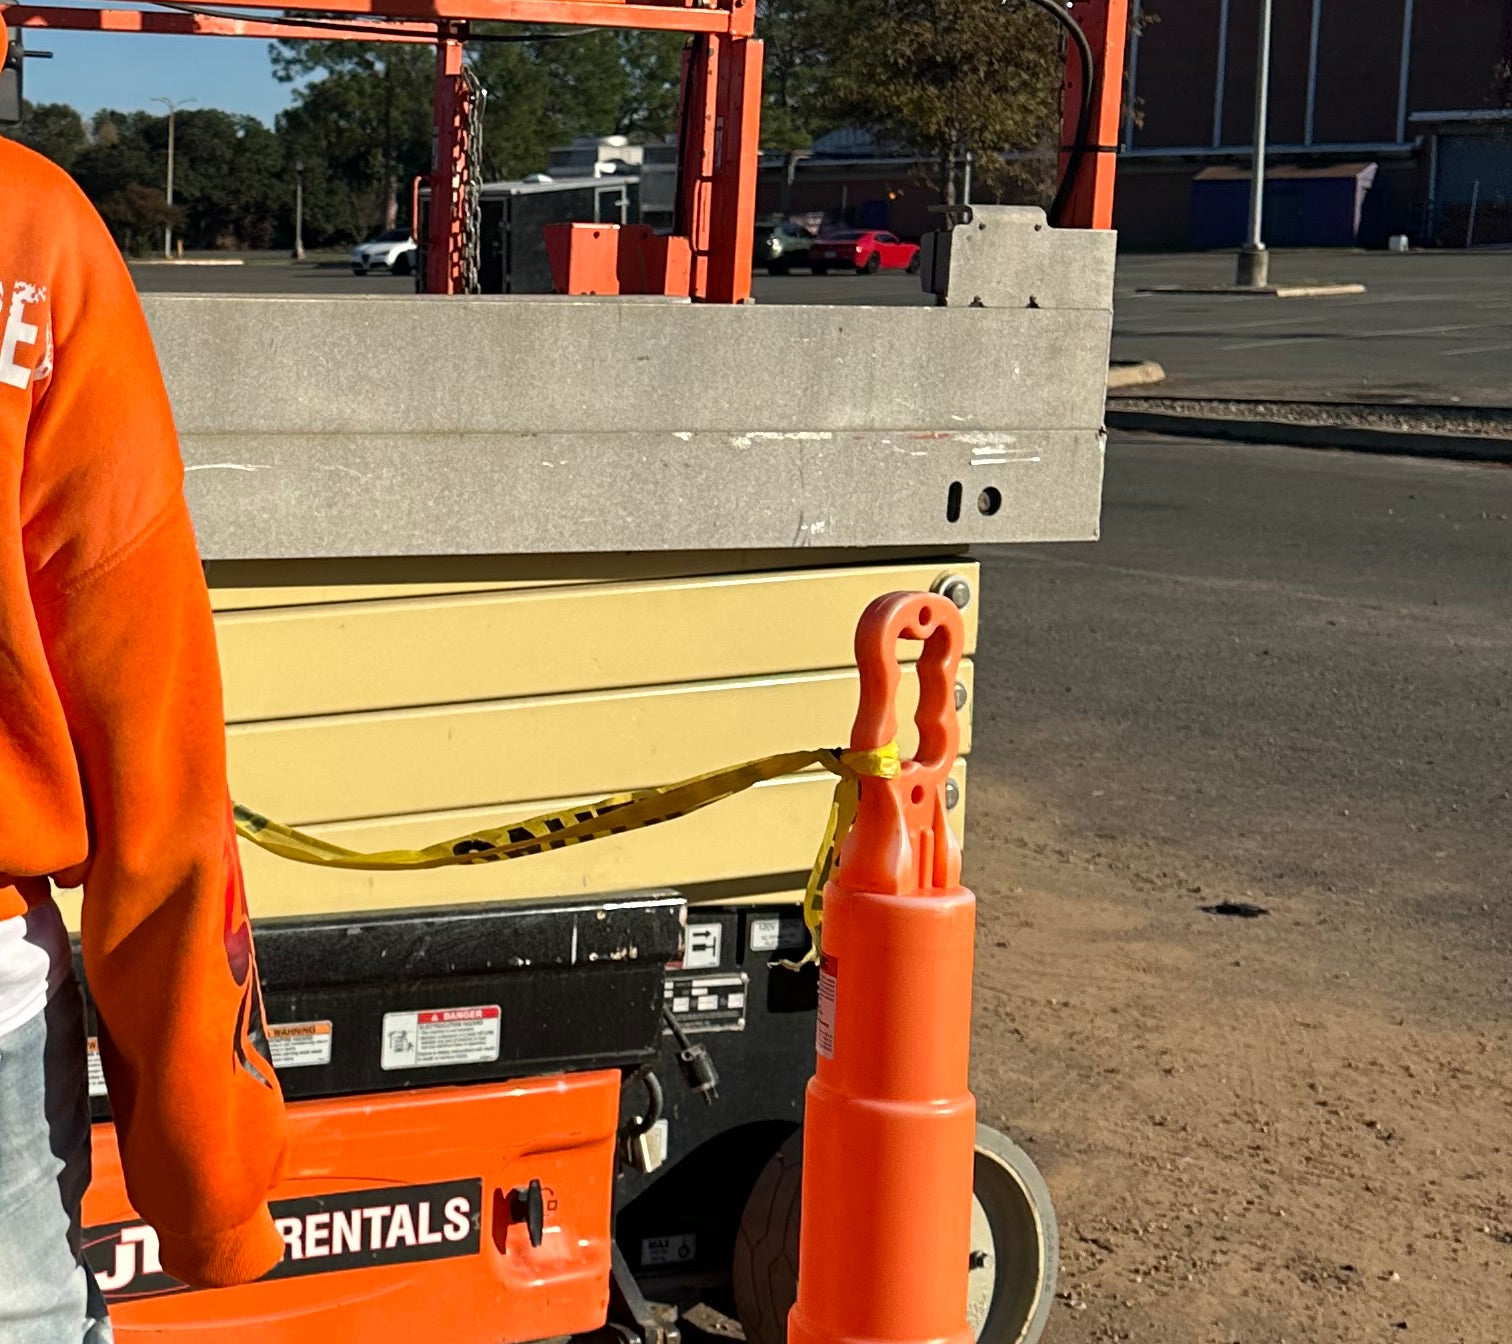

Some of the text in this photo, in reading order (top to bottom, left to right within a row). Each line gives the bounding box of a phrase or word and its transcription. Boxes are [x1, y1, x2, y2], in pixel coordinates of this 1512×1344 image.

[443, 1009, 483, 1021] DANGER
[273, 1024, 316, 1036] WARNING
[273, 1196, 471, 1263] RENTALS
